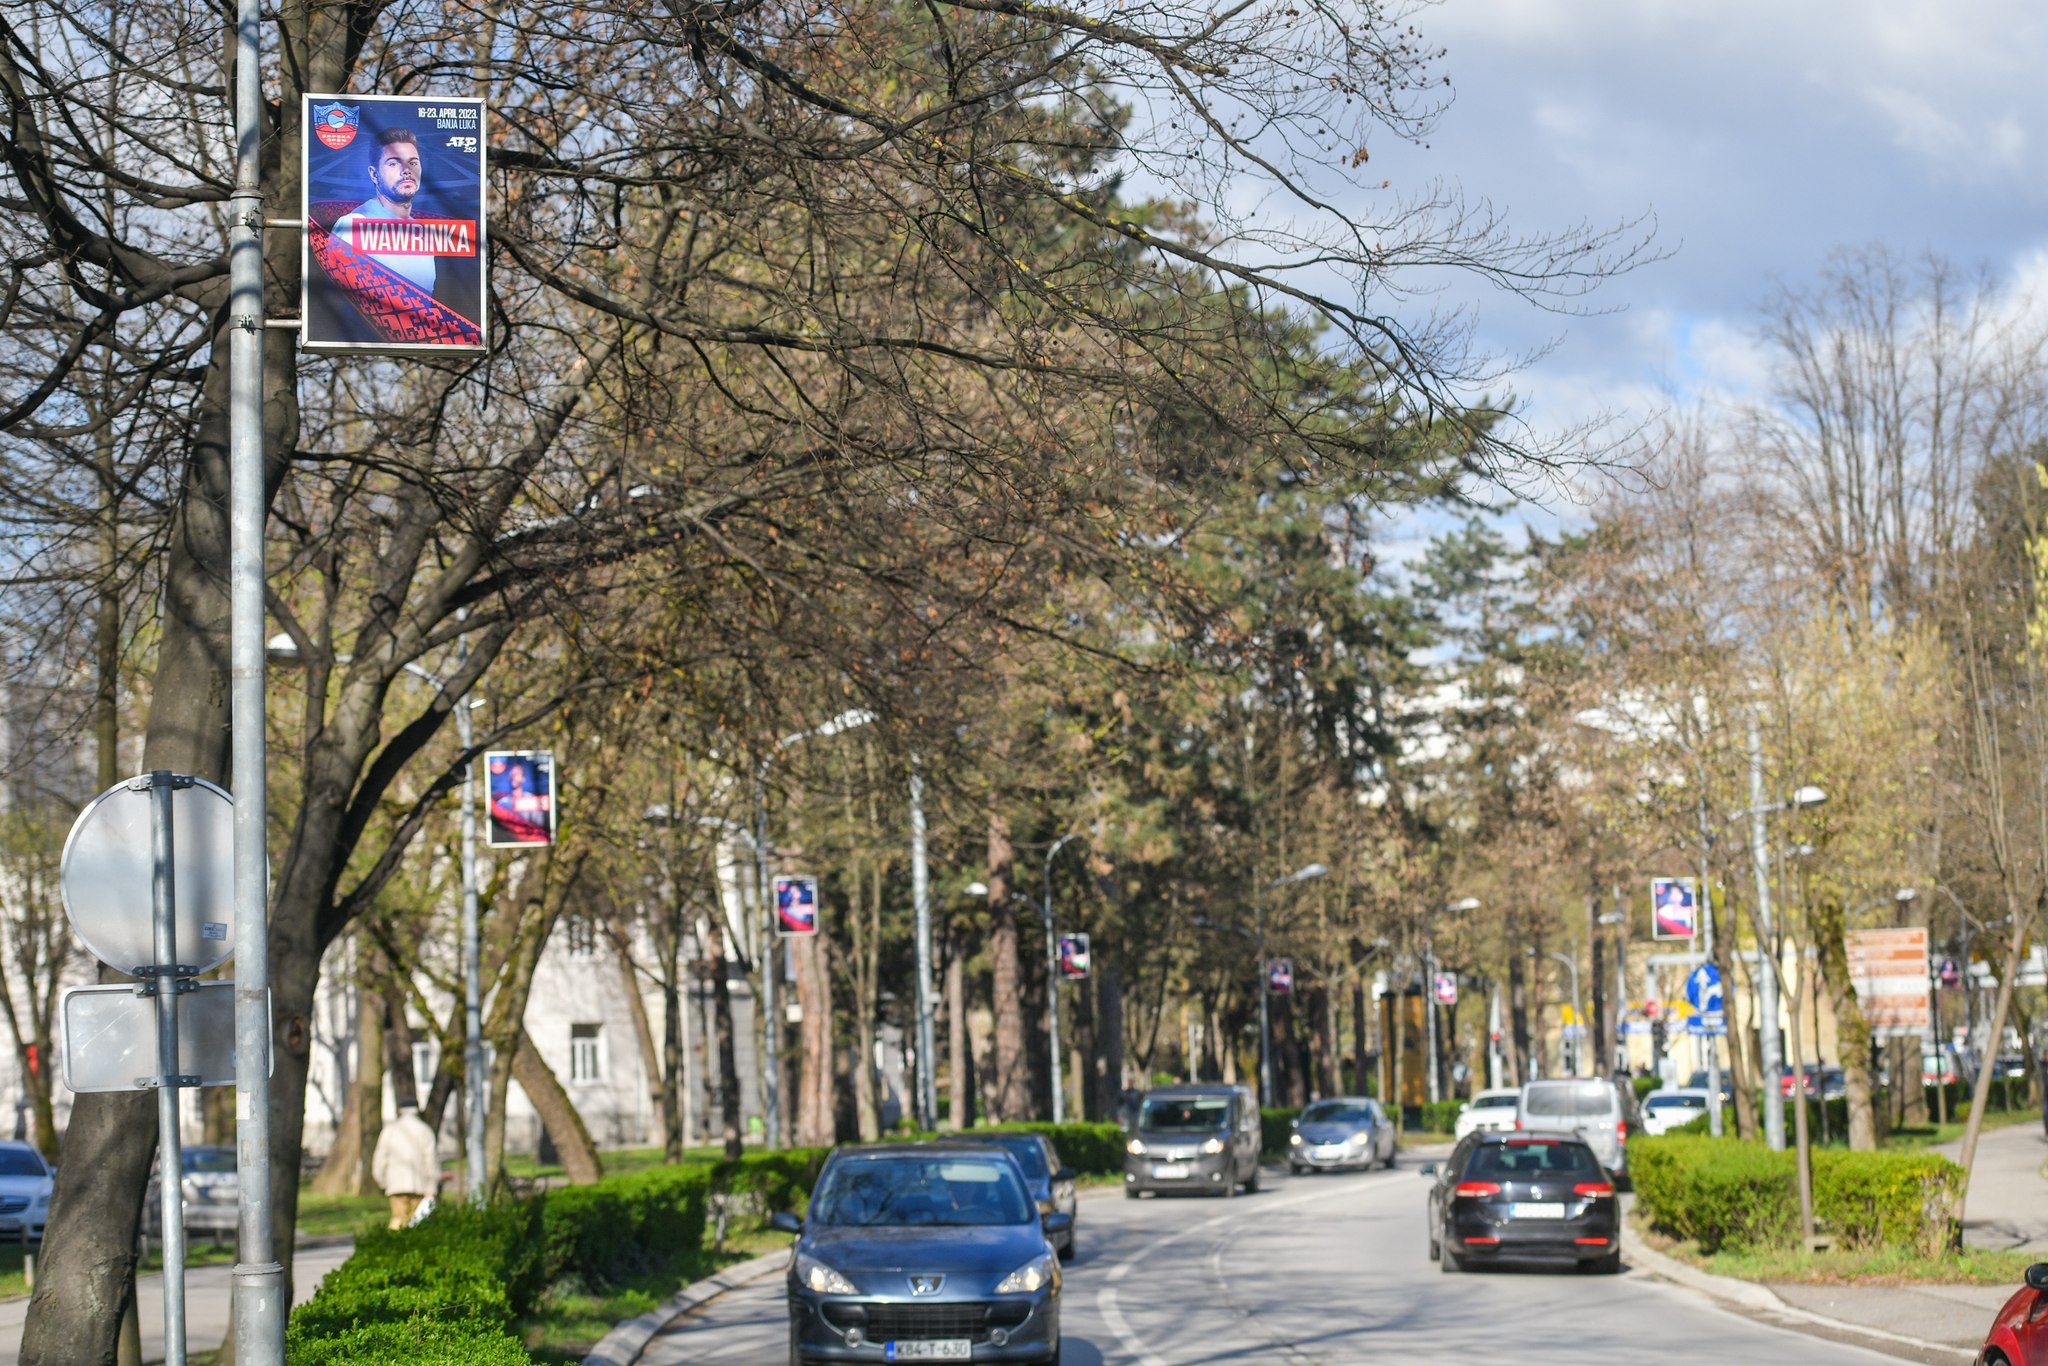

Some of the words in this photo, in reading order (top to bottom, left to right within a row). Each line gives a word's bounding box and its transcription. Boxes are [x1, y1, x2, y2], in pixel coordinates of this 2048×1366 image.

[418, 107, 438, 118] 16-23.
[439, 108, 457, 118] APRIL
[458, 109, 478, 119] 2023.
[437, 119, 458, 129] BANJA
[459, 119, 476, 129] LUKA
[446, 137, 477, 147] ATP
[359, 222, 470, 253] WAWRINKA
